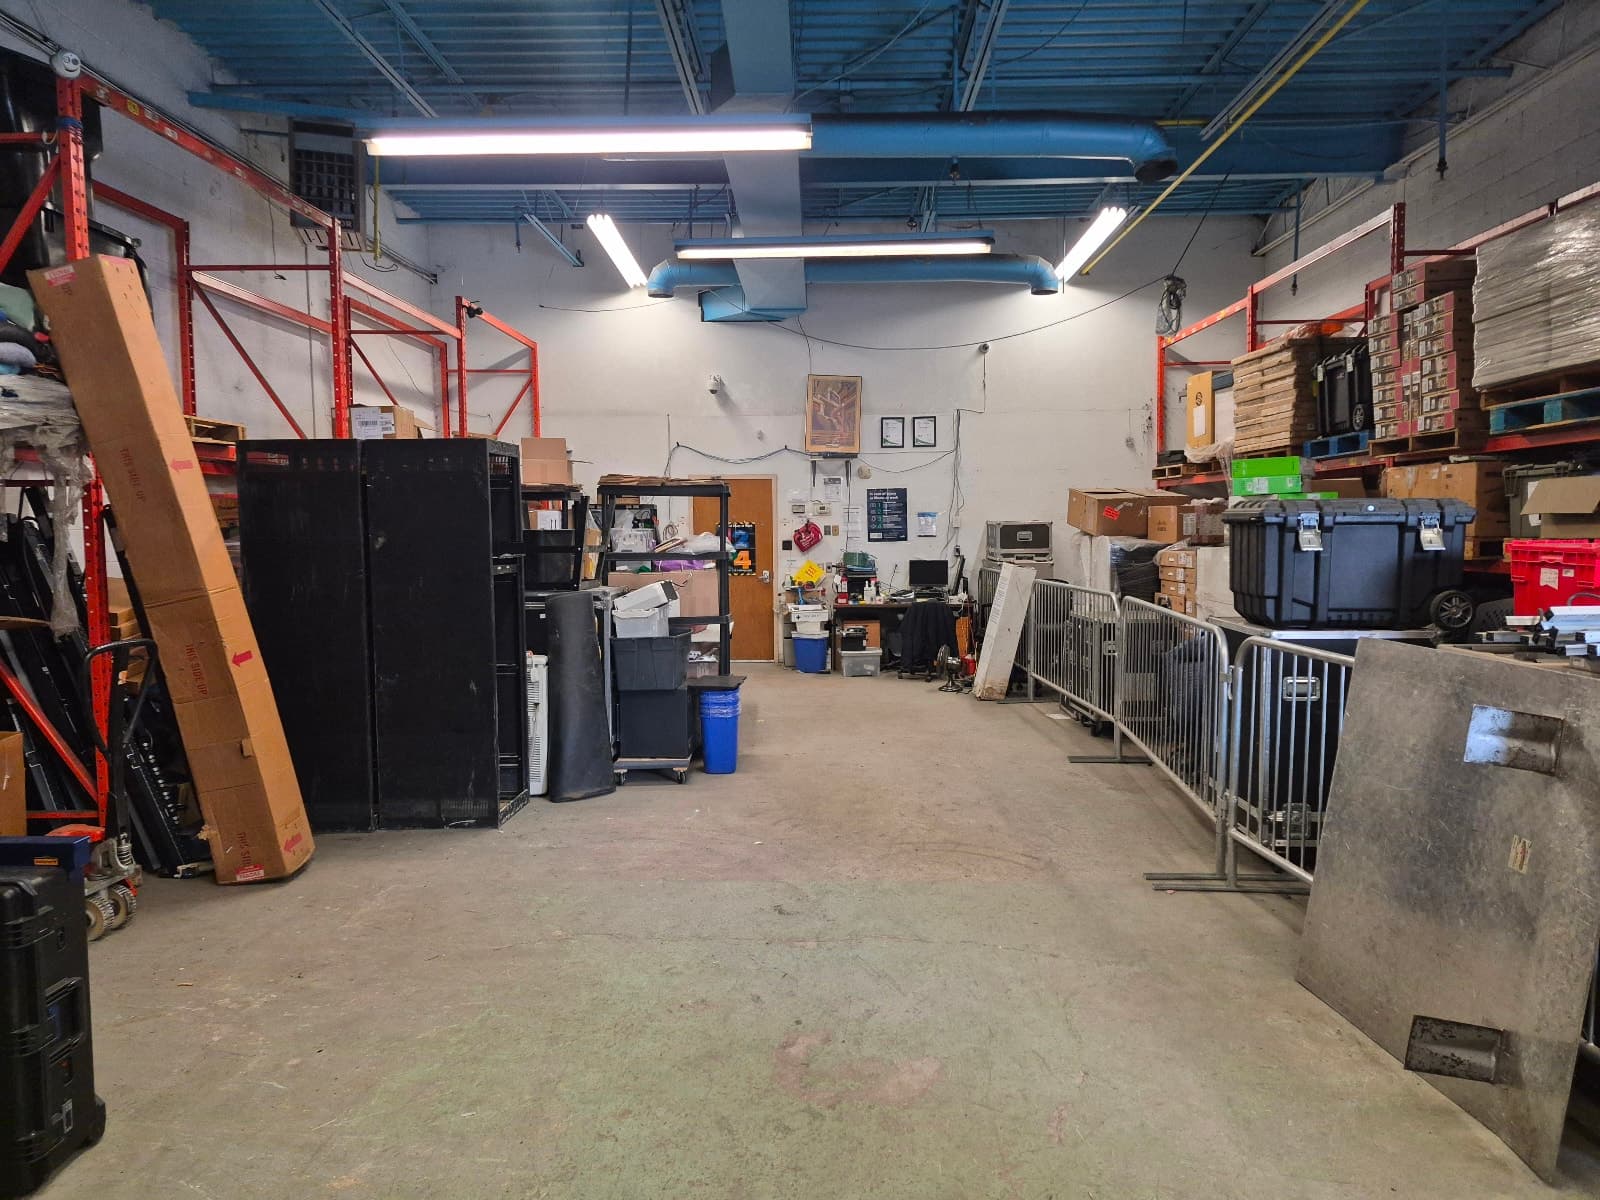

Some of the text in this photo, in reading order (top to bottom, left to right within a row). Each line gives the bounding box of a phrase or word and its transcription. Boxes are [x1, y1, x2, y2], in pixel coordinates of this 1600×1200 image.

[734, 551, 752, 569] 4
[185, 644, 208, 696] THIS SIDE UP
[236, 832, 249, 849] THIS
